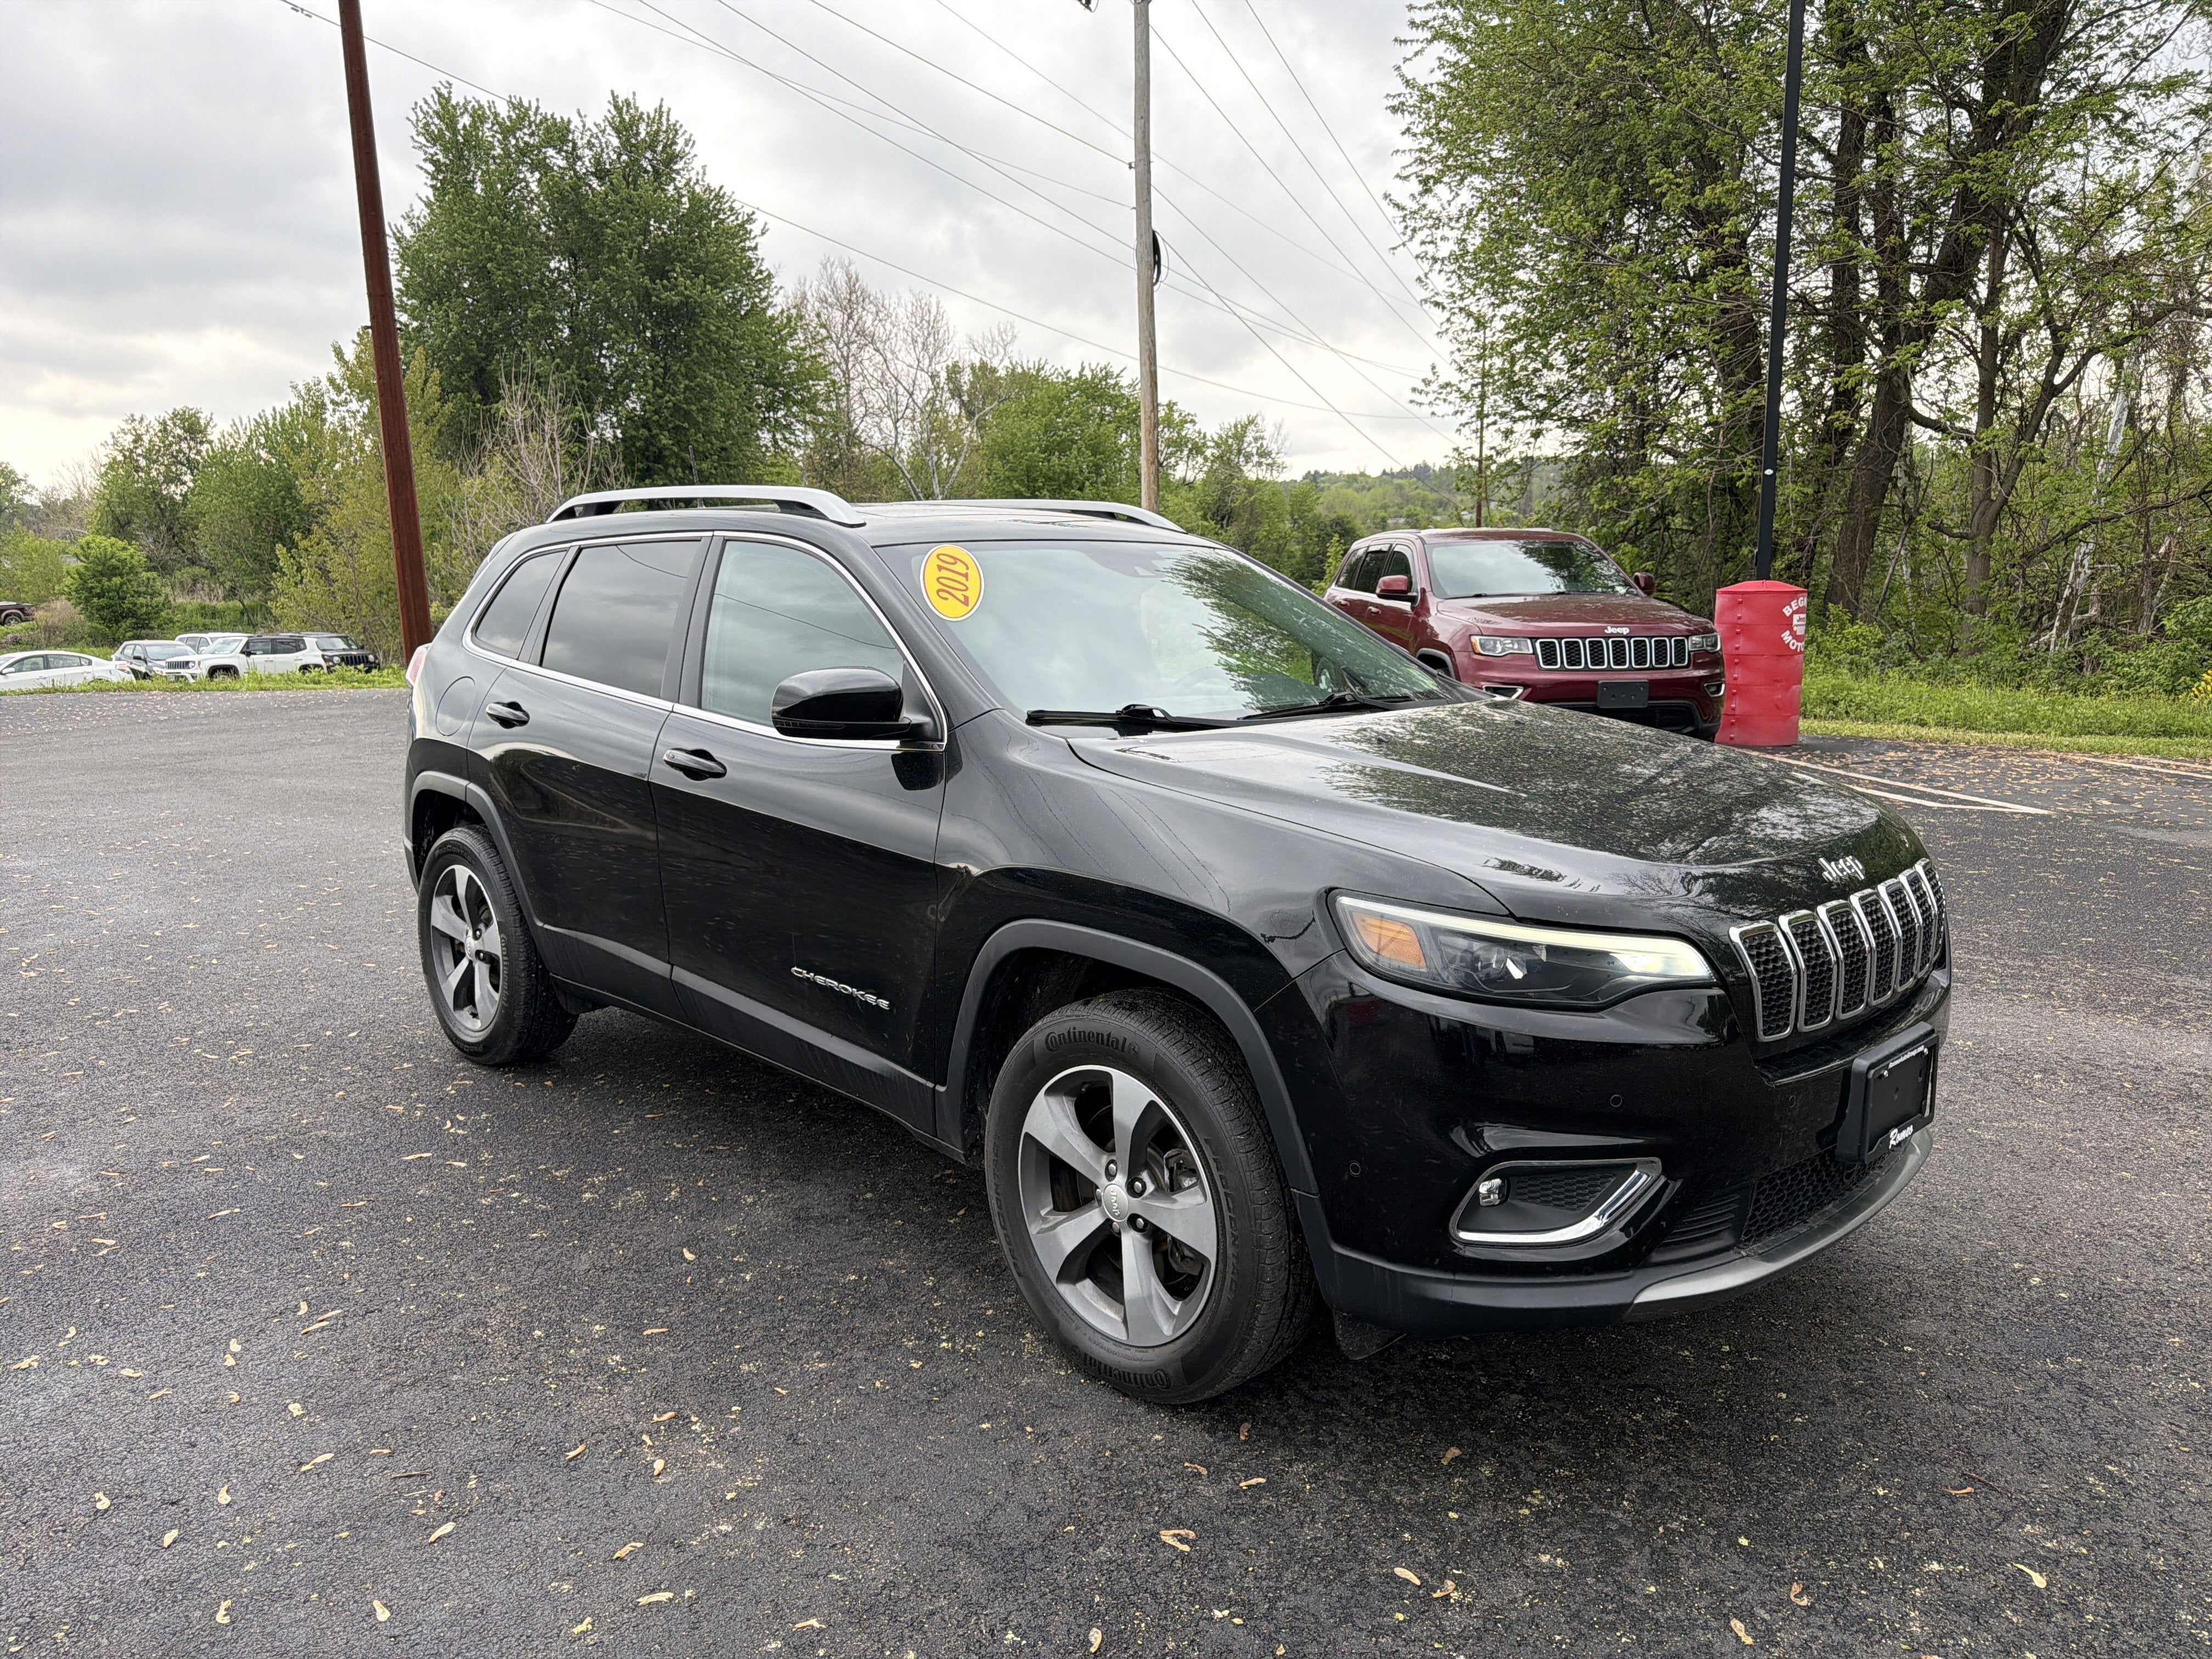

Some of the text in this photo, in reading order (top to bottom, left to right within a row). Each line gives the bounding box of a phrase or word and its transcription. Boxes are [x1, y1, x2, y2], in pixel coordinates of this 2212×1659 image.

[936, 553, 969, 607] 2019
[1604, 625, 1630, 635] Jeep
[1818, 856, 1865, 883] Jeep
[791, 966, 891, 1011] CHEROKEE
[1045, 1026, 1128, 1053] Continental
